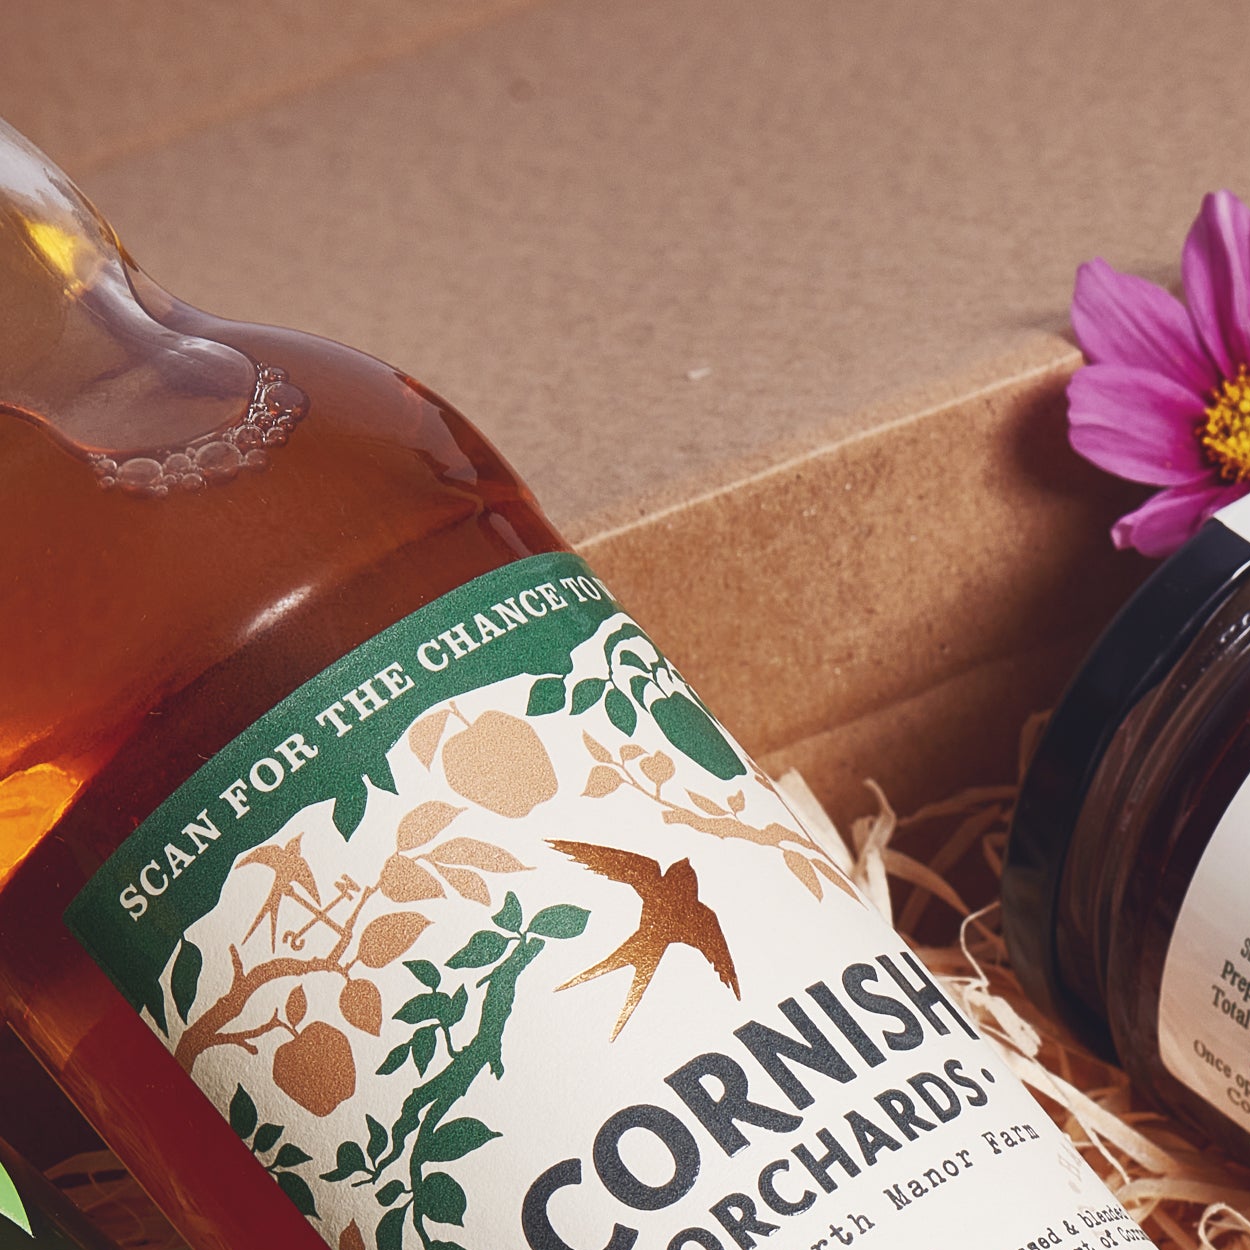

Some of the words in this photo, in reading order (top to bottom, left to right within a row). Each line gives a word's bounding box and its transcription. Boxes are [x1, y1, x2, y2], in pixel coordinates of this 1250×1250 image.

[119, 809, 218, 921] SCAN
[219, 730, 319, 819] FOR
[315, 660, 416, 738] THE
[416, 582, 569, 672] CHANCE
[559, 575, 602, 602] TO
[1193, 1039, 1232, 1079] Once
[883, 1149, 974, 1210] Manor
[981, 1122, 1040, 1155] Farm
[1062, 1219, 1080, 1236] &
[1100, 1229, 1119, 1249] of
[1116, 1226, 1151, 1242] Corn
